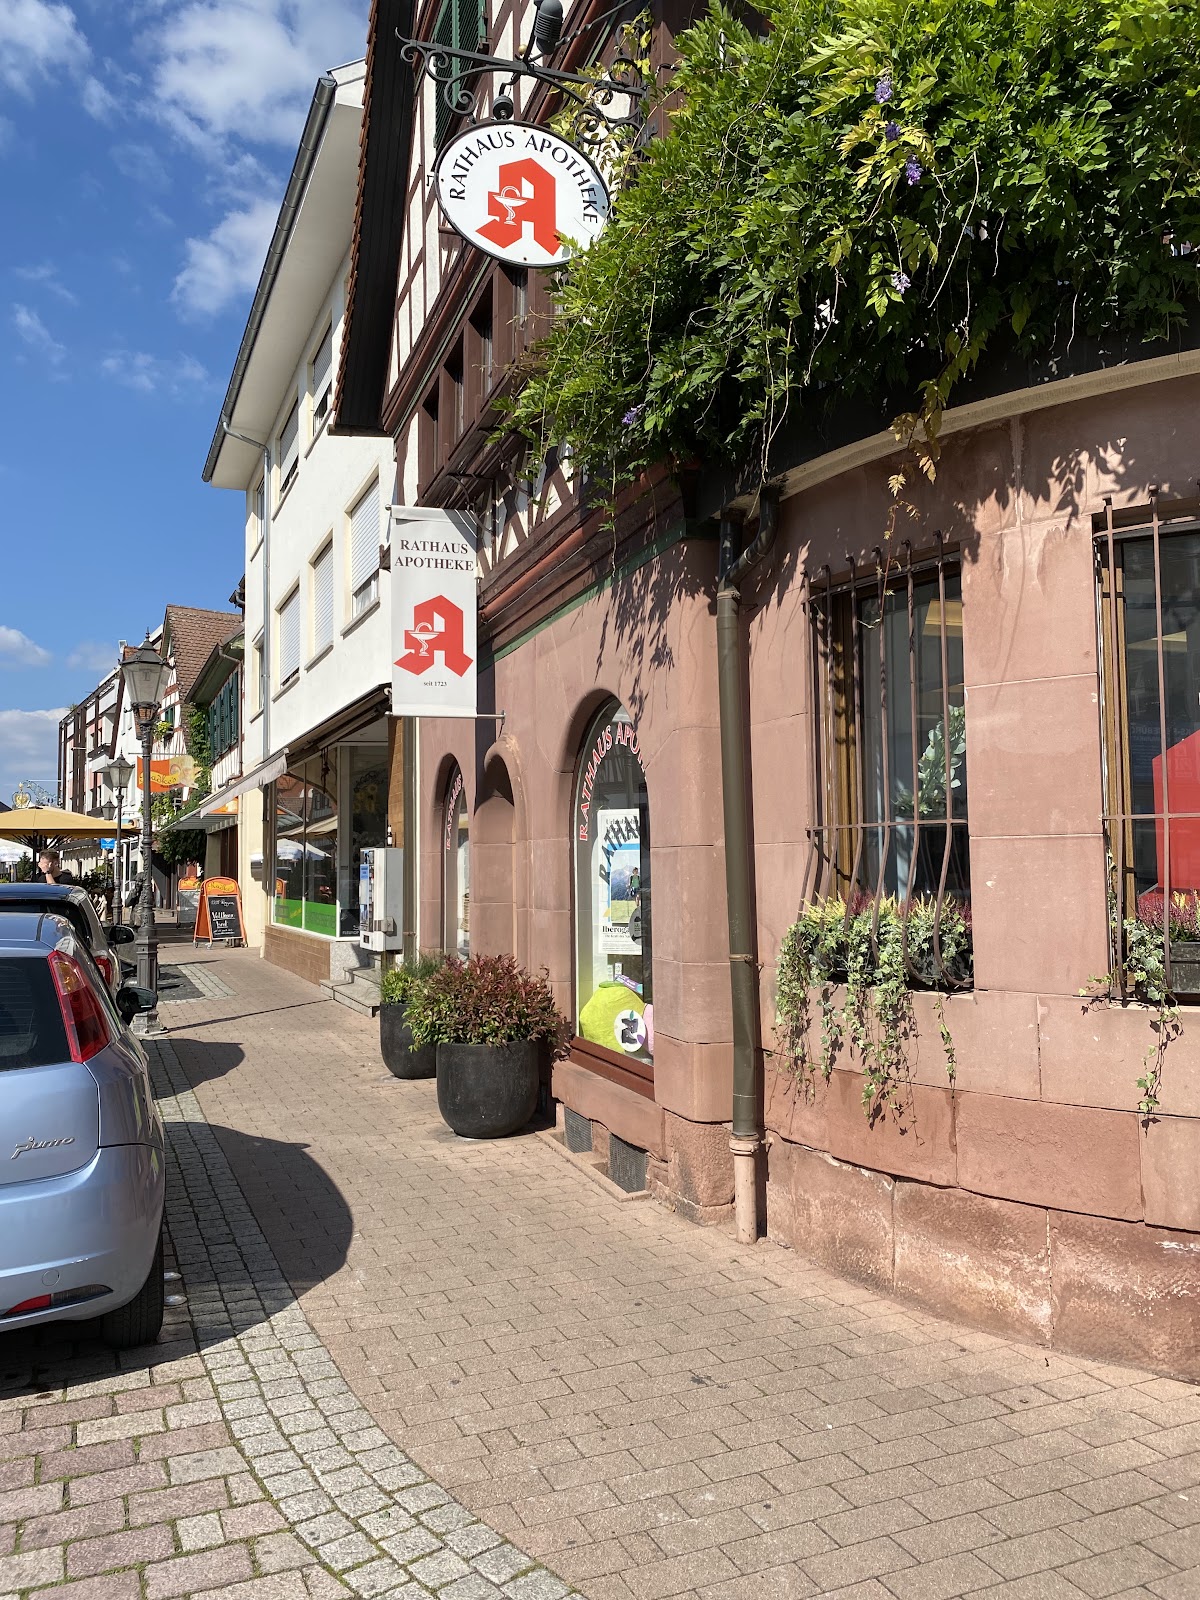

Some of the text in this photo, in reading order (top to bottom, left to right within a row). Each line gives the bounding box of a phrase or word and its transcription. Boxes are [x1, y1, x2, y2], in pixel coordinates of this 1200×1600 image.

[449, 131, 598, 224] RATHAUS APOTHEKE
[394, 556, 474, 572] APOTHEKE
[400, 539, 468, 555] RATHAUS
[579, 724, 613, 842] RATHAUS
